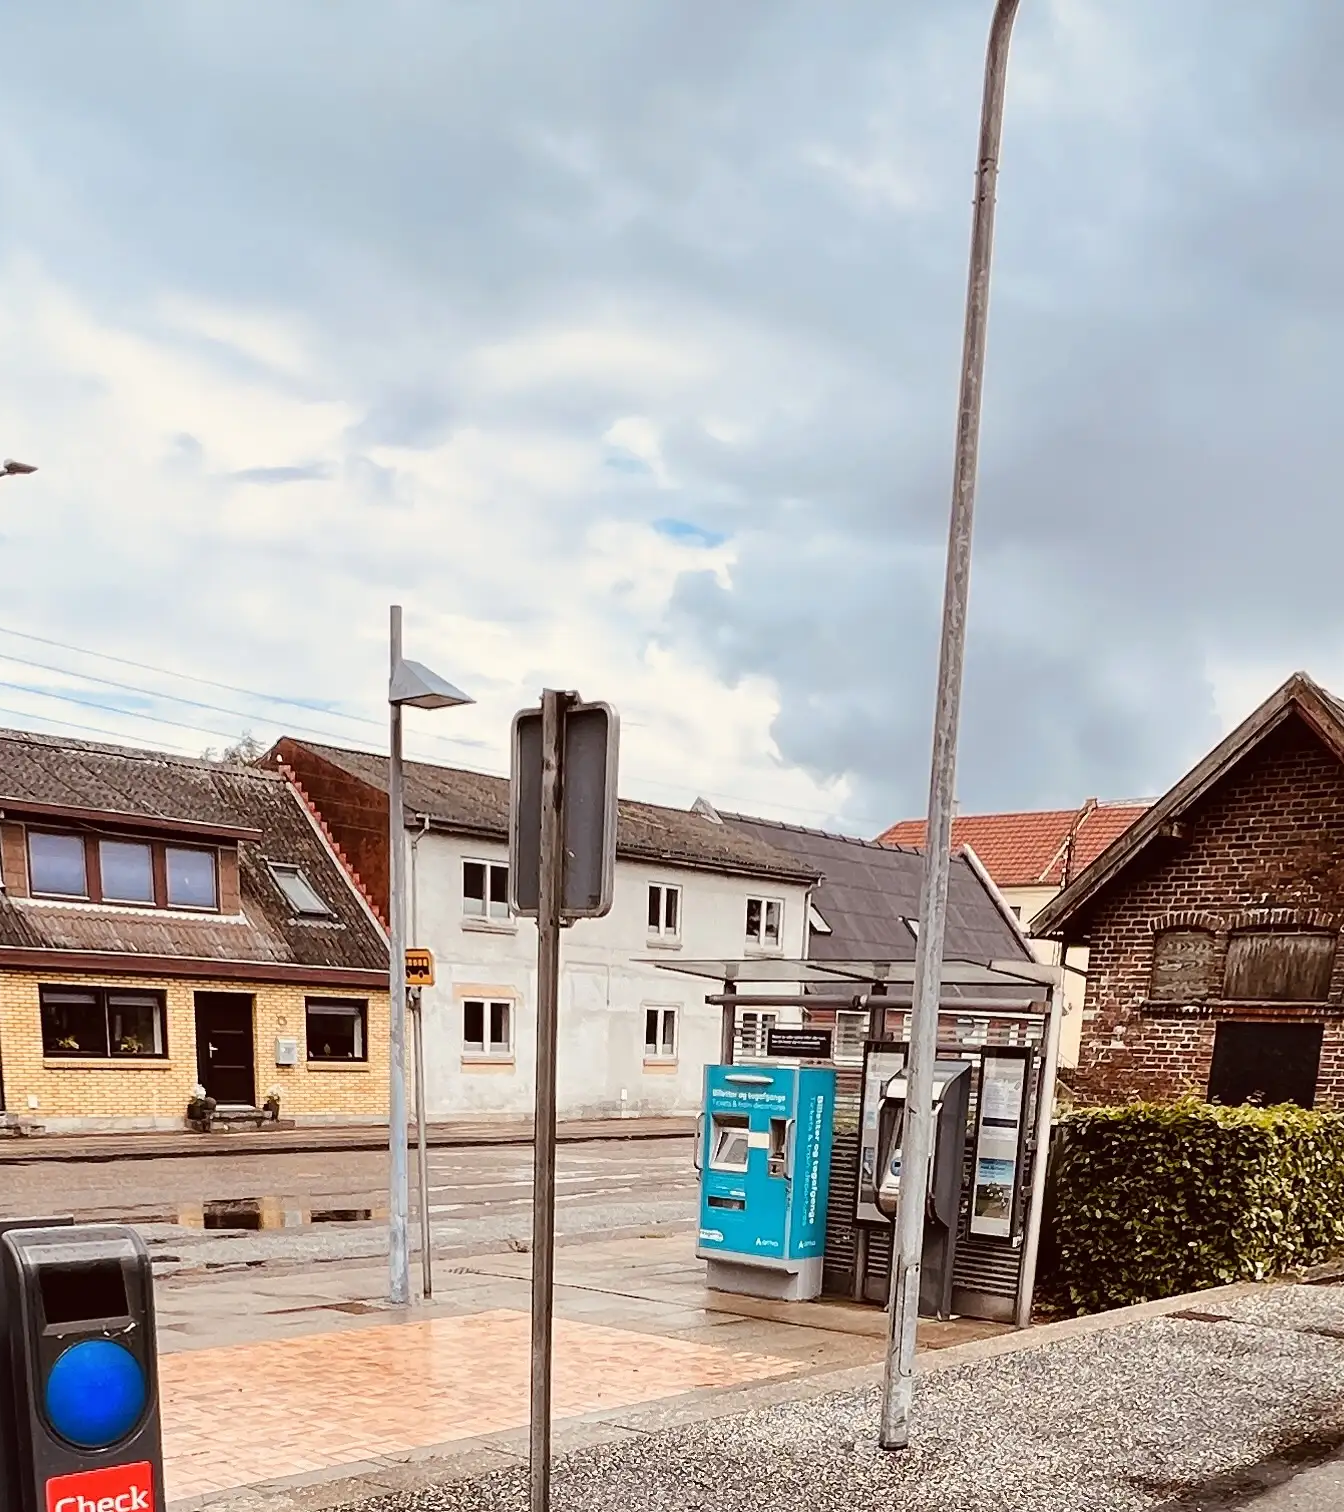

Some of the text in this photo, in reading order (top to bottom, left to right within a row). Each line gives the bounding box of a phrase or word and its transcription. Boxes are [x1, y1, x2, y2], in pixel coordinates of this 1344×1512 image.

[808, 1095, 824, 1224] Billetter og togafgange
